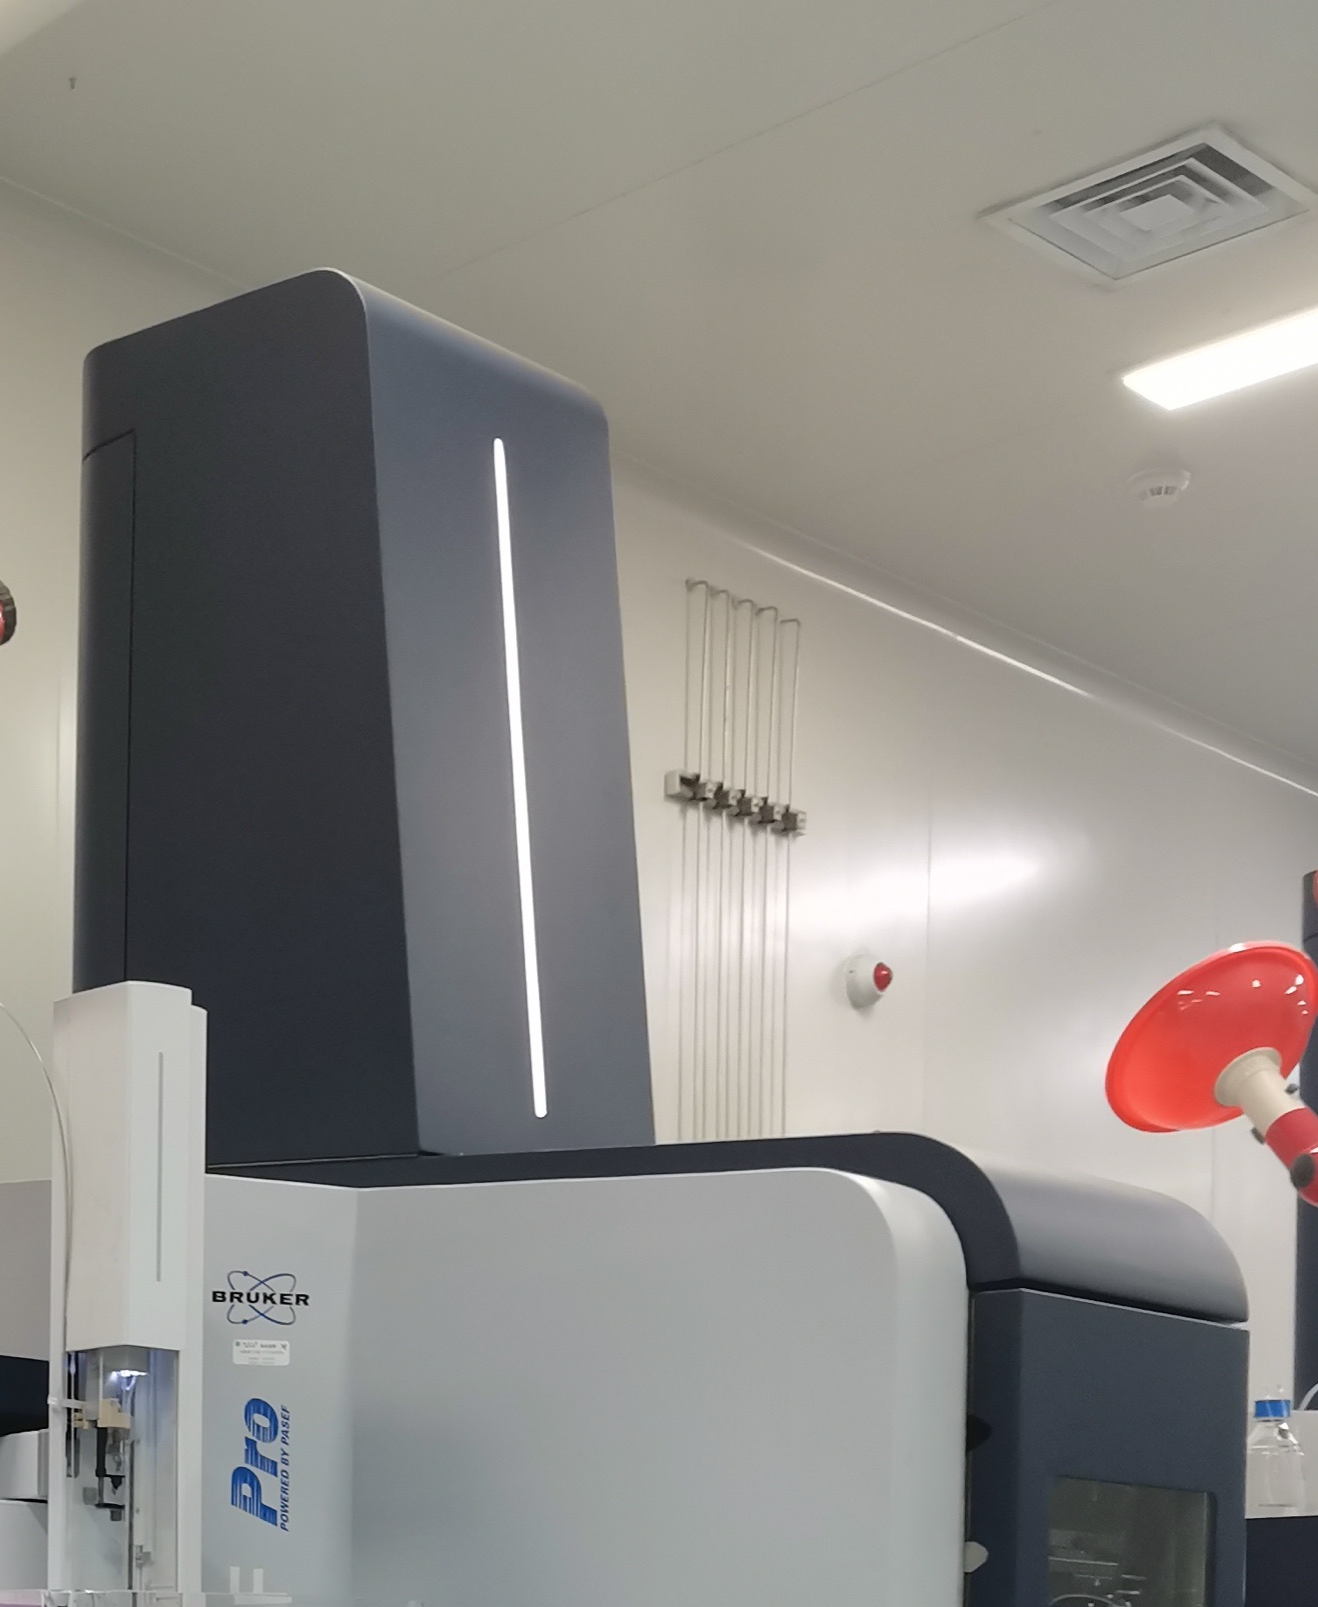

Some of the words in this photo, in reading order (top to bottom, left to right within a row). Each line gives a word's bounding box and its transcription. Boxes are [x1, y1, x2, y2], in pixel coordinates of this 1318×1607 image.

[212, 1290, 310, 1306] BRUKER
[280, 1404, 290, 1446] PASEF
[231, 1398, 279, 1527] Pro
[280, 1447, 290, 1467] BY
[280, 1470, 290, 1532] POWERED
